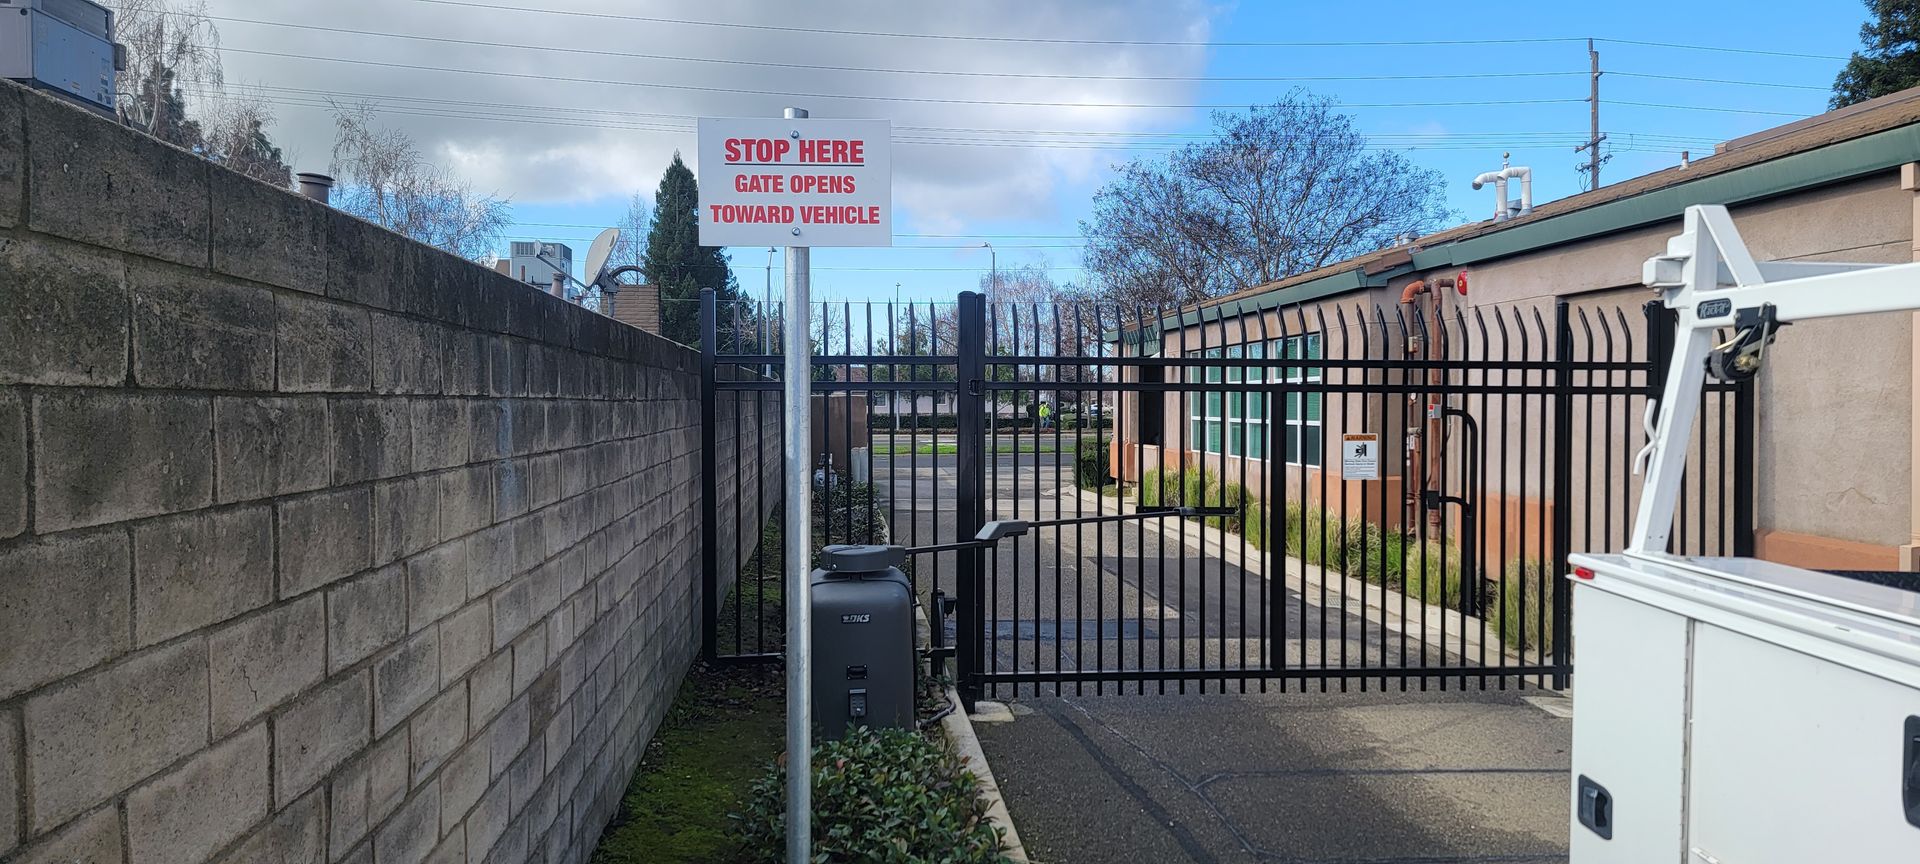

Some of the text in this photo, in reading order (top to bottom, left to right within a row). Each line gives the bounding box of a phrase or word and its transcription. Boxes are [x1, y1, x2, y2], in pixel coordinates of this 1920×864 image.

[725, 138, 864, 163] STOP HERE
[735, 174, 855, 194] GATE OPENS
[710, 204, 880, 224] TOWARD VEHICLE
[850, 614, 870, 623] DKS
